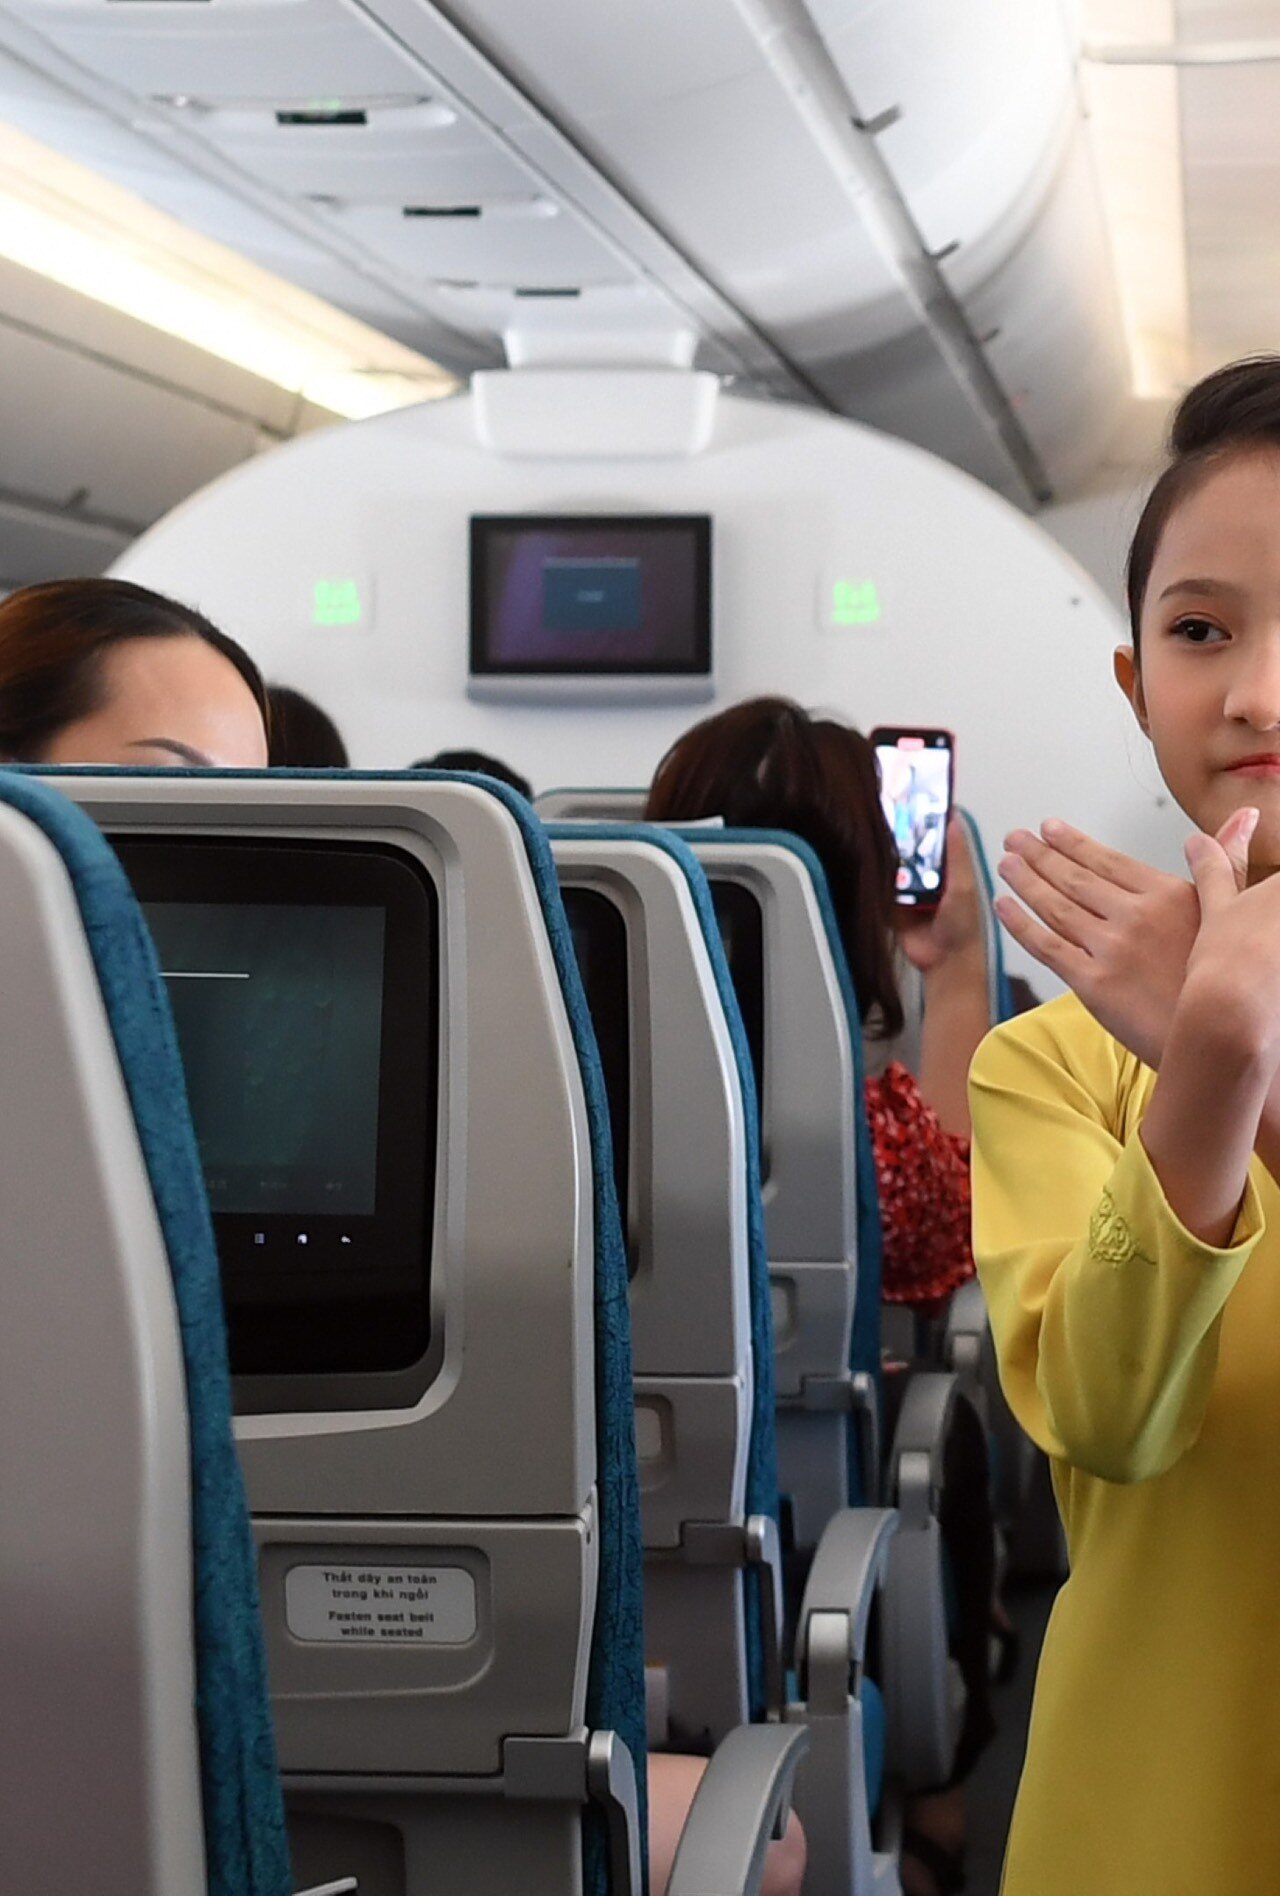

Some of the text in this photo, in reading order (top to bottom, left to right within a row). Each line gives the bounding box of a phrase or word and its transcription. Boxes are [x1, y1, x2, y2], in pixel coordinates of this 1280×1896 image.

[387, 1574, 403, 1584] an
[332, 1588, 368, 1600] trong
[373, 1589, 394, 1599] khi
[328, 1610, 434, 1622] Fasten seat belt
[341, 1627, 423, 1637] while seated
